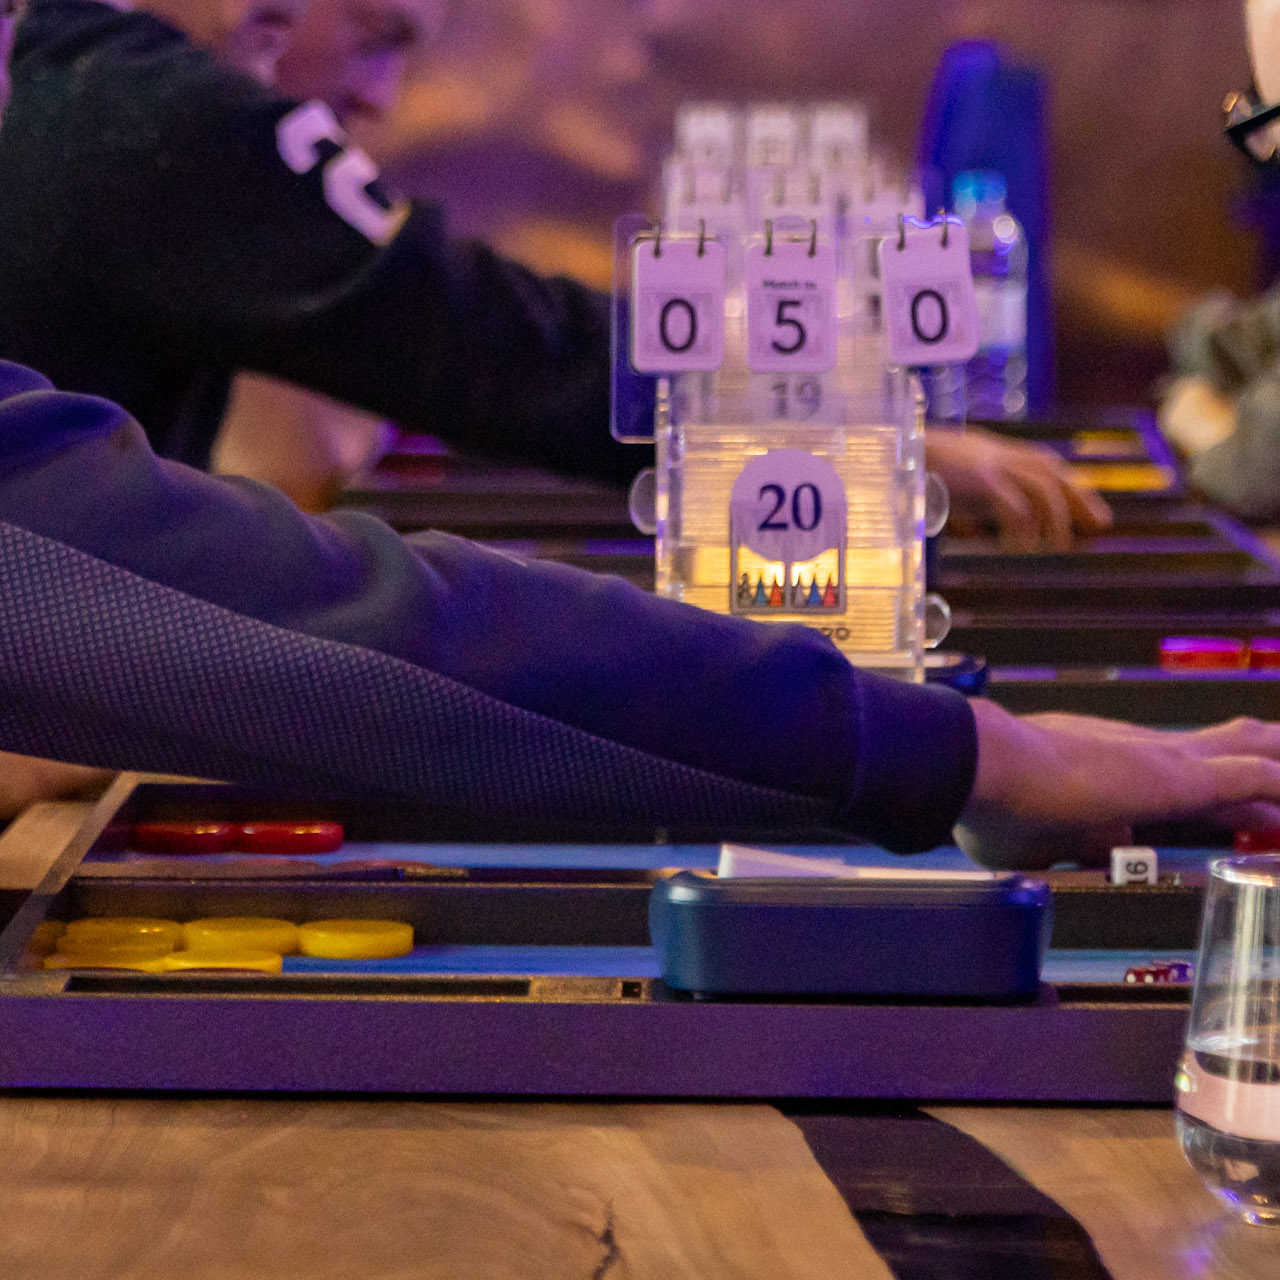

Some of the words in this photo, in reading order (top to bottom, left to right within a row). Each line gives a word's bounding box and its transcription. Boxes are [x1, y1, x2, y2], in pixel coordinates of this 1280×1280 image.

[659, 297, 698, 355] 0
[771, 299, 807, 355] 5
[910, 288, 949, 346] 0
[757, 482, 823, 532] 20
